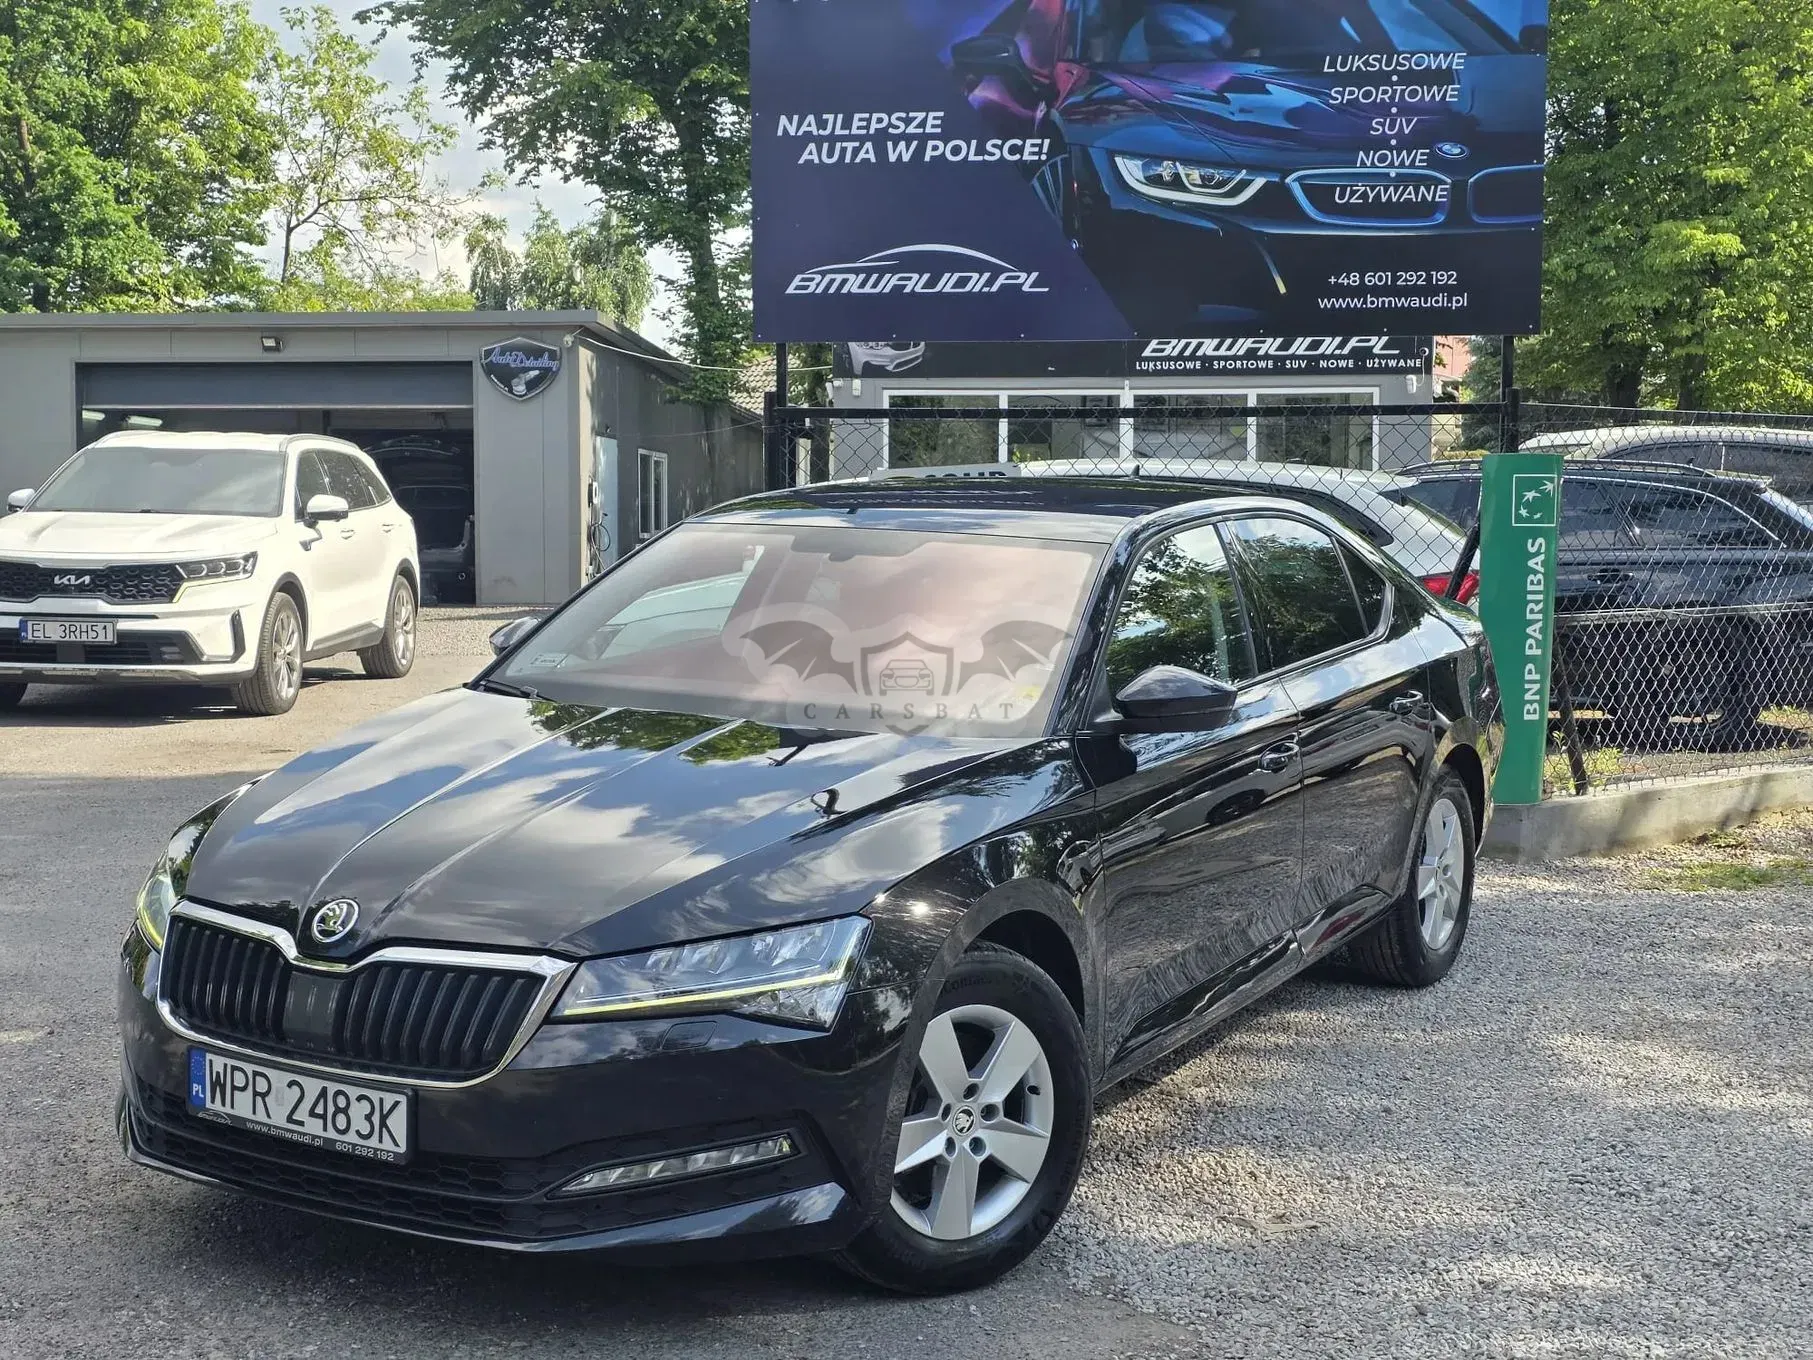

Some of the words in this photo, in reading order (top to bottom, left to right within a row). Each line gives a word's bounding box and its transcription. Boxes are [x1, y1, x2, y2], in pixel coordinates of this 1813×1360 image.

[1323, 52, 1467, 73] LUKSUSOWE
[1329, 85, 1461, 104] SPORTOWE
[776, 111, 945, 137] NAJLEPSZE
[1369, 117, 1418, 136] SUV
[797, 141, 876, 165] AUTA
[886, 140, 918, 163] W
[923, 138, 1051, 163] POLSCE!
[1356, 149, 1430, 168] NOWE
[1333, 182, 1450, 204] UŻYWANE
[784, 271, 1051, 294] BMWAUDI.PL
[1327, 272, 1361, 287] +48
[1363, 272, 1393, 286] 601
[1396, 271, 1427, 286] 292
[1430, 270, 1458, 285] 192
[1317, 292, 1469, 311] www.bmwaudi.pl
[1140, 335, 1401, 358] BMWAUDI.PL
[1135, 359, 1202, 371] LUKSUSOWE
[1212, 359, 1275, 370] SPORTOWE
[1285, 358, 1308, 369] SUV
[1319, 358, 1355, 369] NOWE
[1366, 356, 1423, 369] UŻYWANE
[1526, 537, 1546, 655] PARIBAS
[31, 623, 52, 639] EL
[59, 623, 108, 640] 3RH51
[1524, 663, 1540, 720] BNP
[192, 1083, 205, 1098] PL
[208, 1058, 273, 1120] WPR
[285, 1078, 403, 1148] 2483K
[245, 1120, 324, 1147] www.bmwaudi.pl
[335, 1141, 353, 1153] 601
[354, 1145, 375, 1158] 292
[376, 1150, 395, 1162] 192
